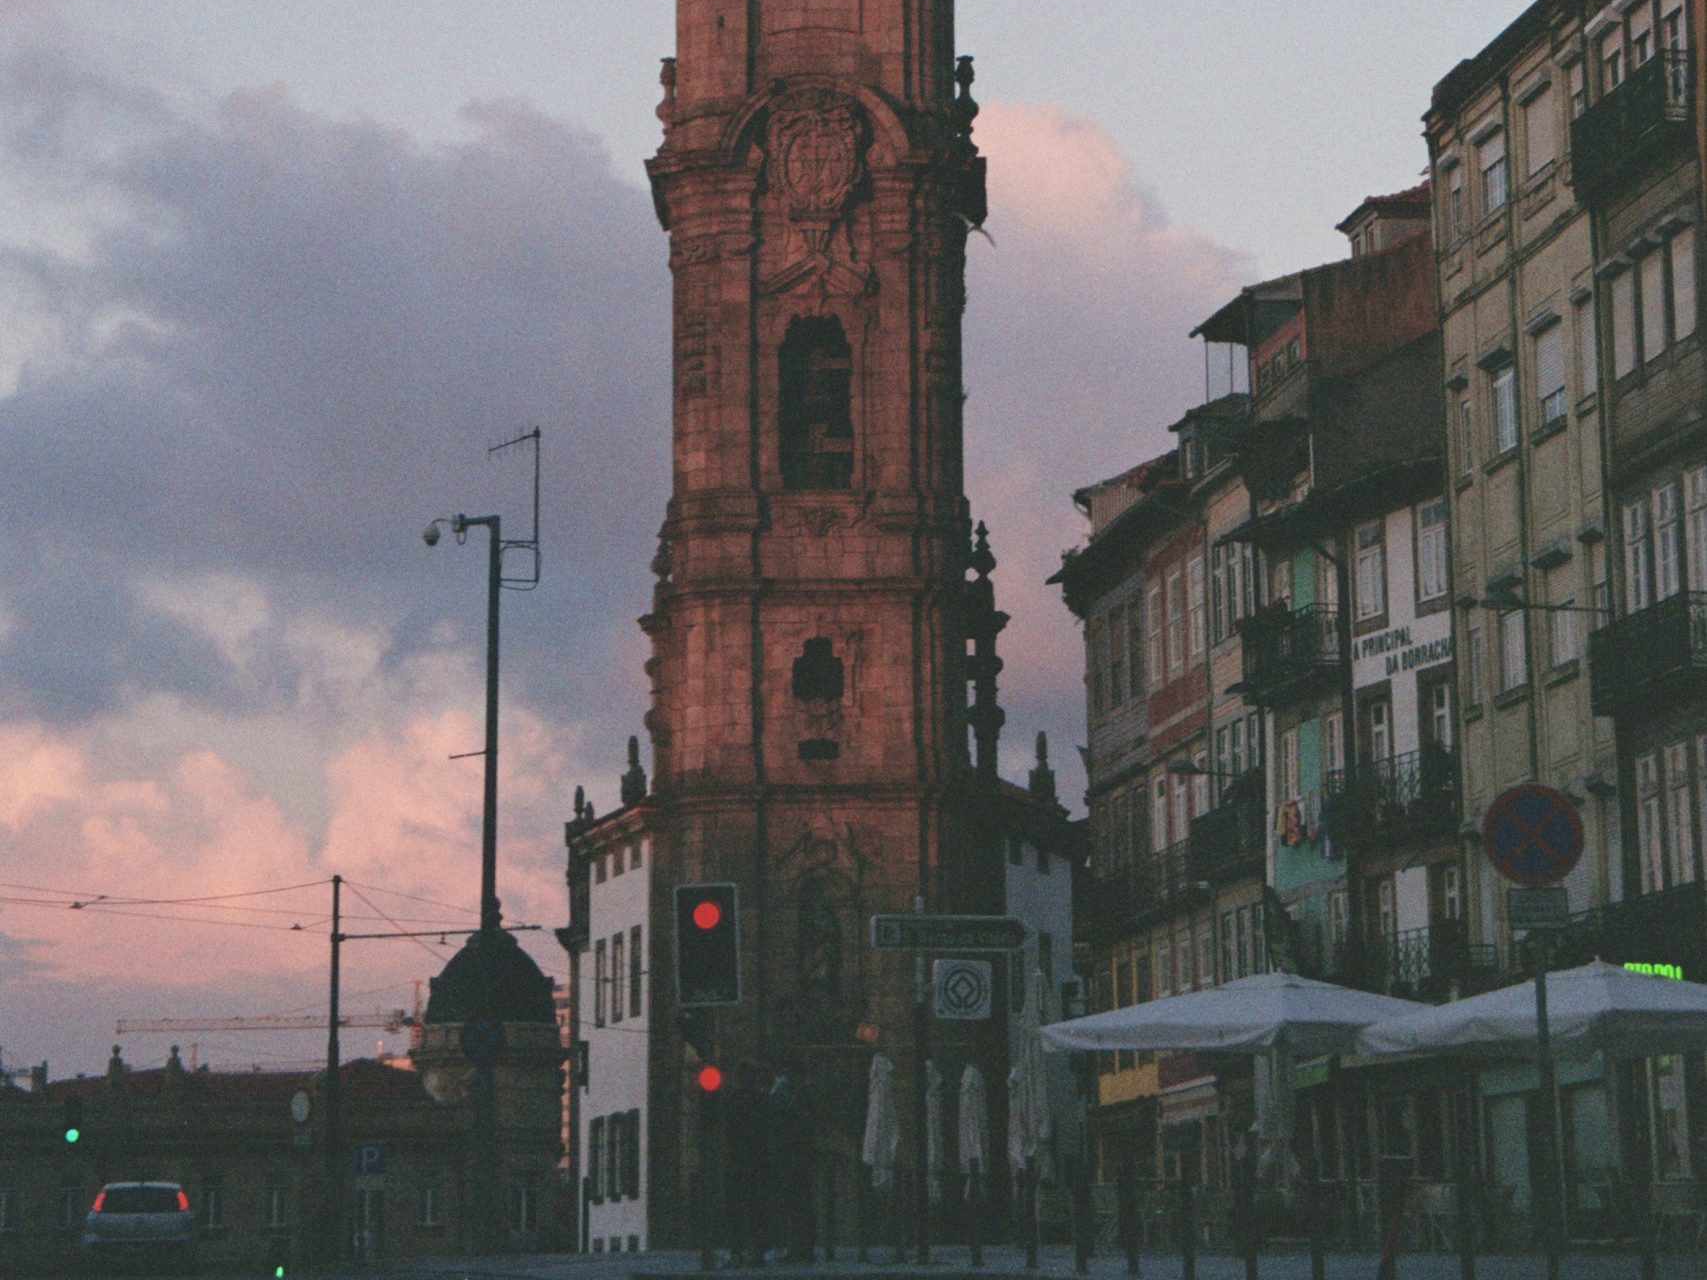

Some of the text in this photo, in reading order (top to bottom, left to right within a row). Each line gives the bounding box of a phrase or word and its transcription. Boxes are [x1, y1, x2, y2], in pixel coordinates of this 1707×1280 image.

[1353, 626, 1412, 660] A PRINCIPAL
[1385, 653, 1400, 675] DA
[362, 1146, 380, 1173] P
